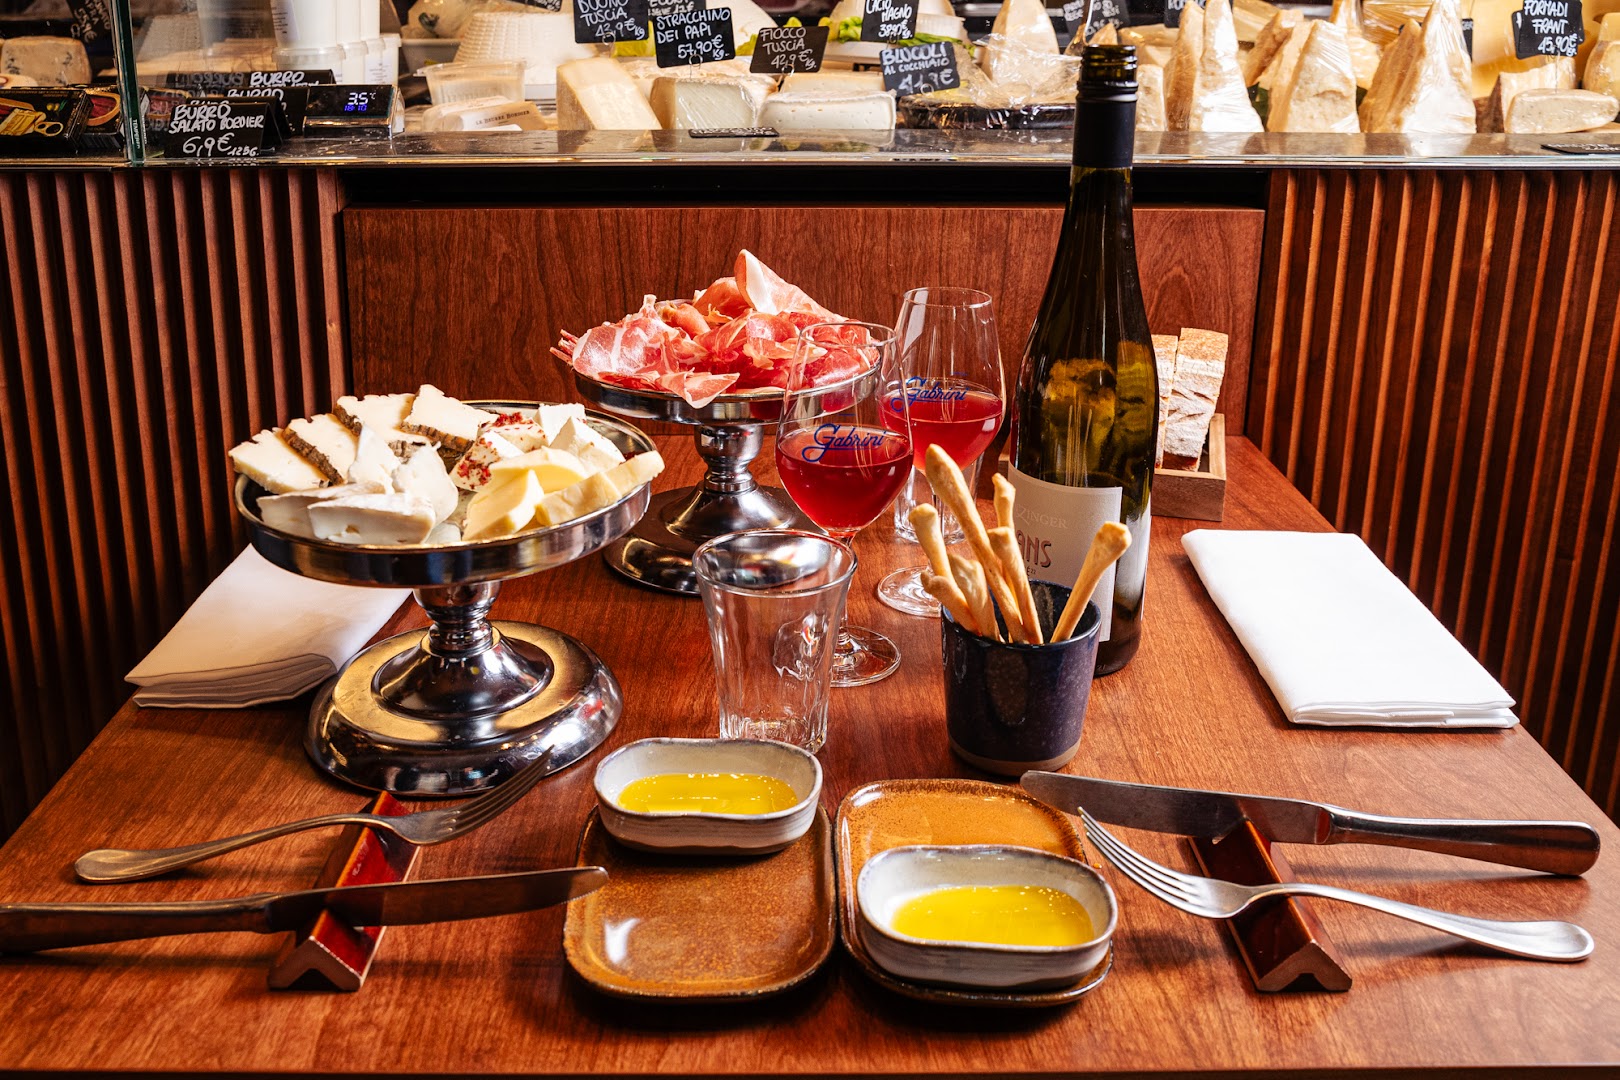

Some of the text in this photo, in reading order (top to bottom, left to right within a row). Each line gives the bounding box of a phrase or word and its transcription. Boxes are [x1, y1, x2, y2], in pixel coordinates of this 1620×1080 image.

[656, 9, 730, 30] STRACCHINO
[881, 4, 912, 23] MAGNO
[656, 22, 712, 44] DEI PAPI
[760, 27, 807, 41] FIOCCO
[1531, 18, 1568, 35] FRANT
[249, 71, 305, 87] BURRO
[884, 65, 896, 76] AL
[173, 104, 232, 121] BURRO
[168, 118, 217, 134] SALATO
[889, 375, 972, 412] Gabrini
[801, 423, 887, 463] Gabrini
[1015, 505, 1068, 530] ZINGER
